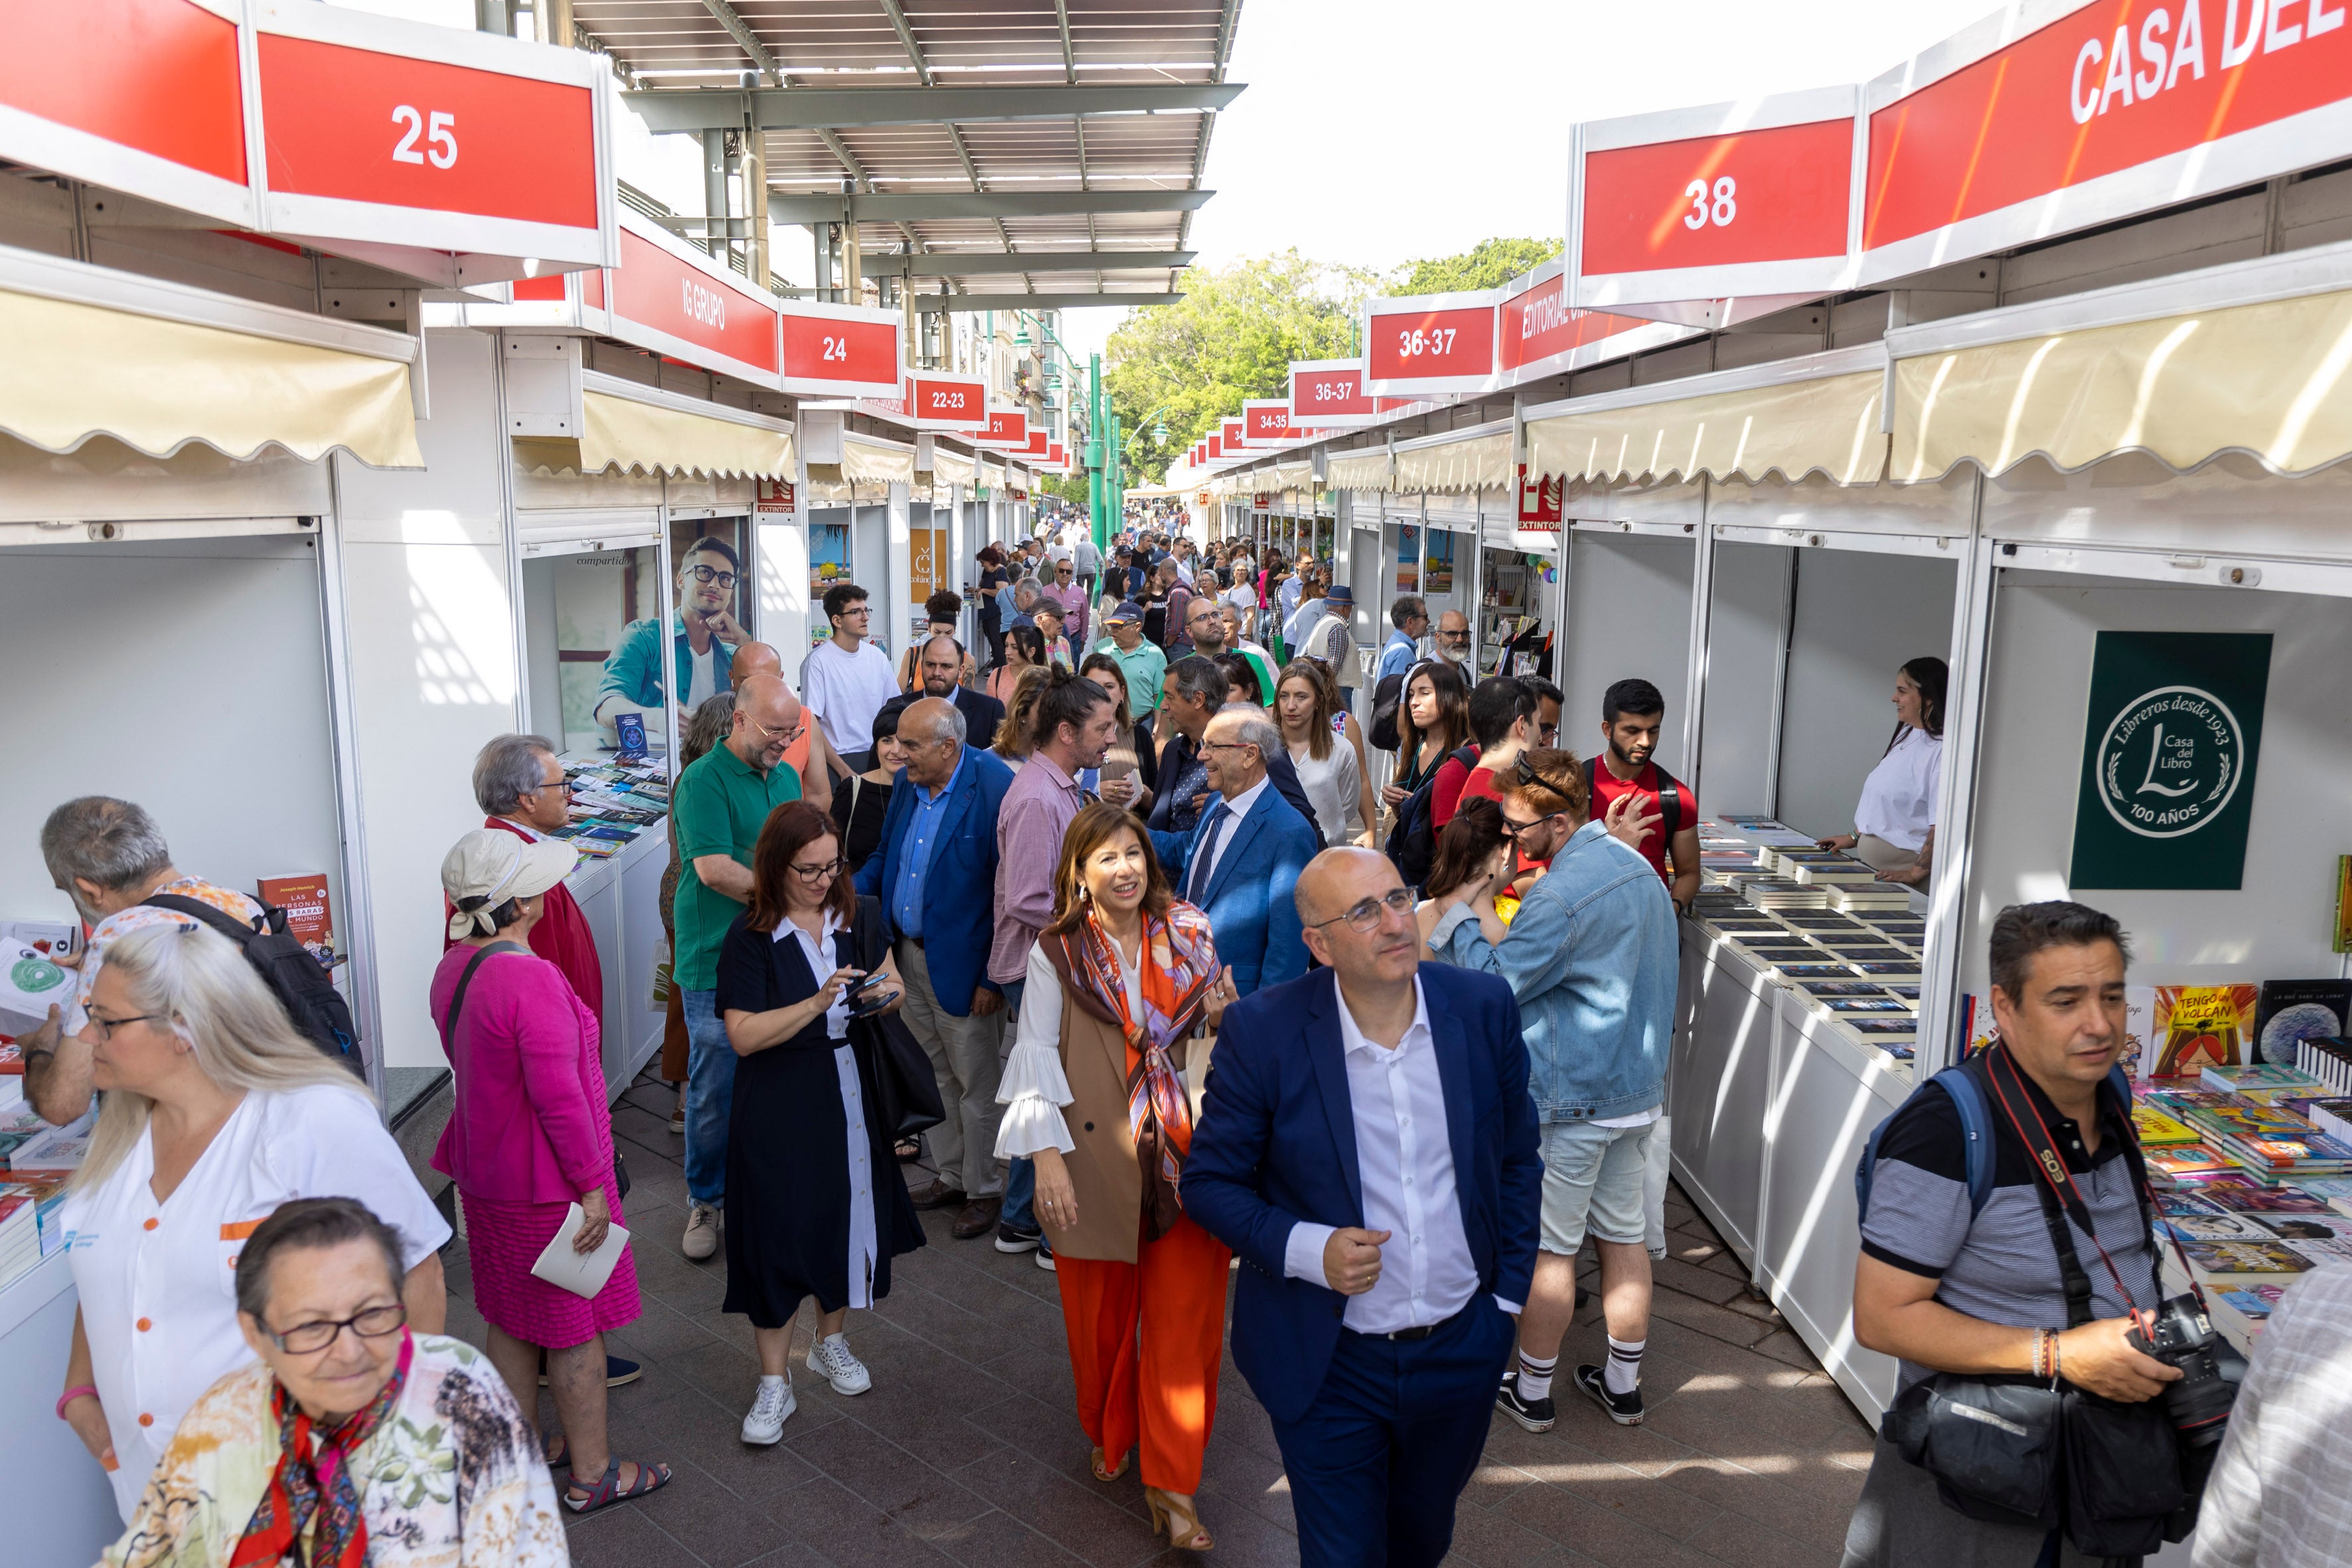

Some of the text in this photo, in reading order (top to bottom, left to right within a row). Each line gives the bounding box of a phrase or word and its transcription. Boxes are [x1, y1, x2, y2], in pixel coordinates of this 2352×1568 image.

[2071, 0, 2205, 124] CASA
[392, 105, 458, 169] 25
[1684, 176, 1737, 230] 38
[682, 277, 725, 331] IG GRUPO
[1522, 290, 1569, 340] EDITORIAL
[823, 337, 846, 362] 24
[1399, 329, 1456, 357] 36-37
[932, 392, 965, 408] 22-23
[1315, 382, 1353, 401] 36-37
[993, 420, 1003, 432] 21
[1260, 415, 1287, 429] 34-35
[1518, 520, 1561, 530] EXTINTOR
[576, 556, 631, 566] compartido
[2114, 695, 2230, 745] Libreros desde 1923
[2165, 735, 2194, 747] Casa
[2177, 748, 2193, 758] del
[2160, 757, 2192, 769] Libro
[2130, 803, 2199, 824] 100 AÑOS
[2180, 994, 2217, 1009] TENGO
[2183, 1002, 2231, 1019] VOLCÁN
[2039, 1149, 2066, 1183] EOS
